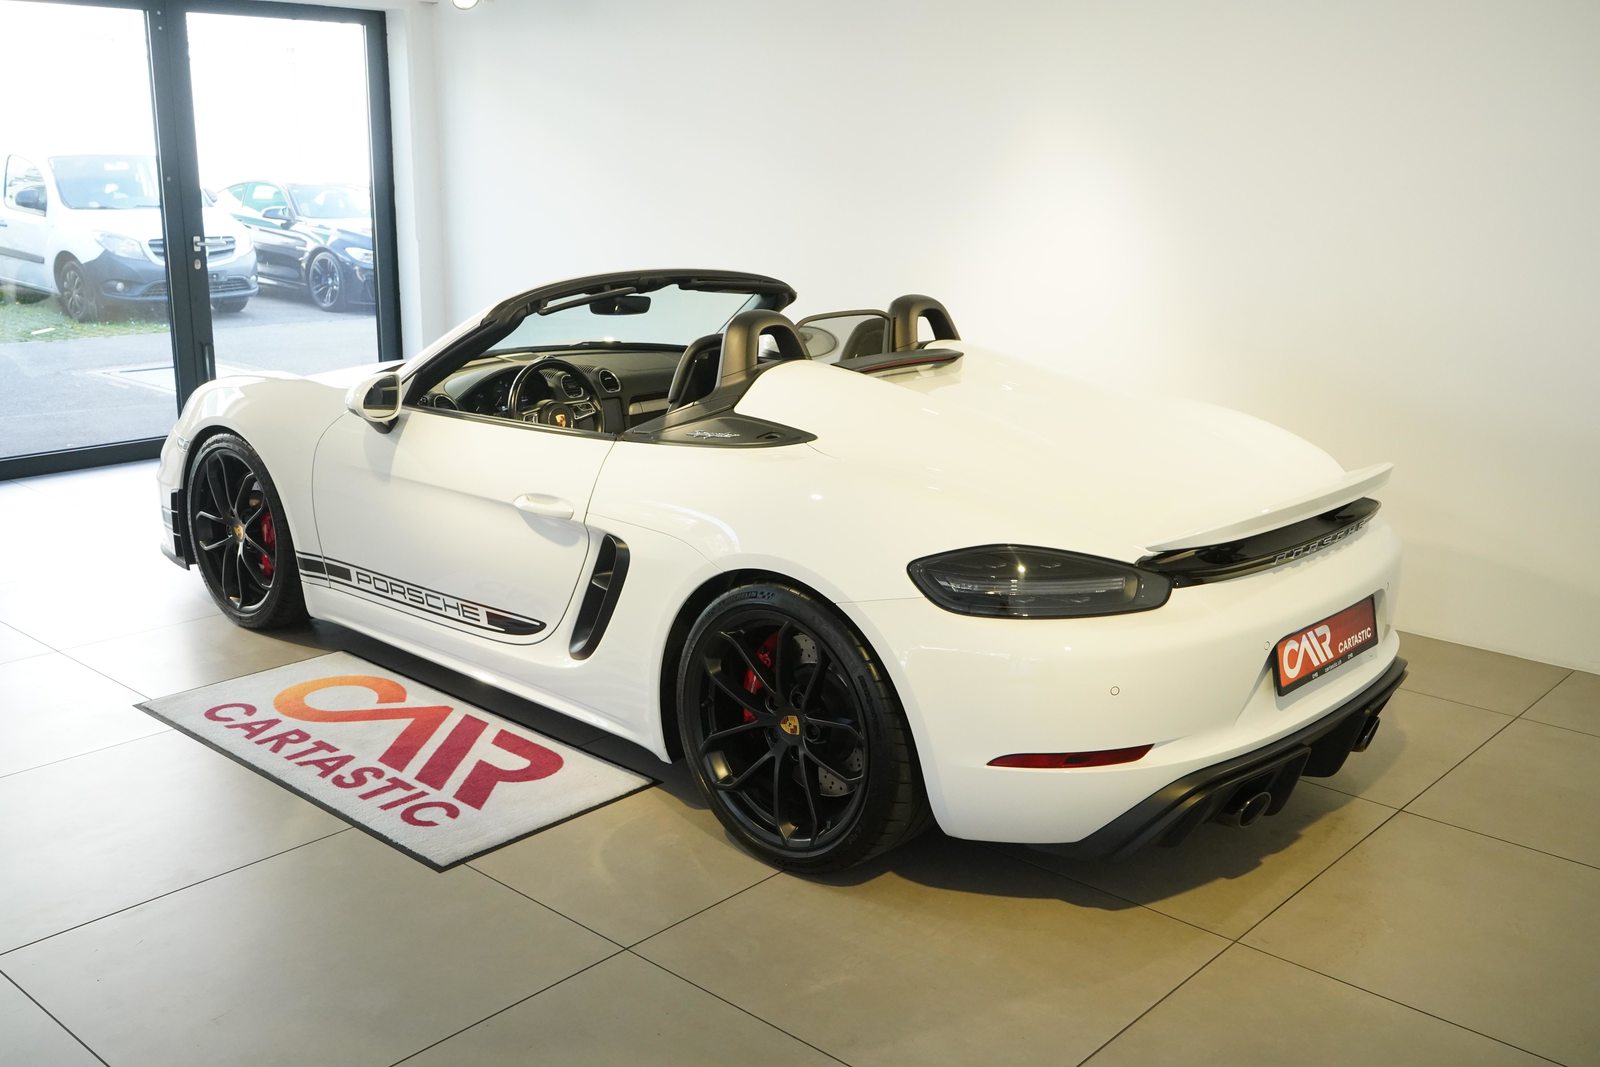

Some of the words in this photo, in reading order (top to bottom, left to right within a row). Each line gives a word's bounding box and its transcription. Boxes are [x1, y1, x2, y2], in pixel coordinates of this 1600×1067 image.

[355, 571, 481, 622] PORSCHE
[1337, 627, 1373, 654] CARTASTIC
[204, 702, 461, 827] CARTASTIC
